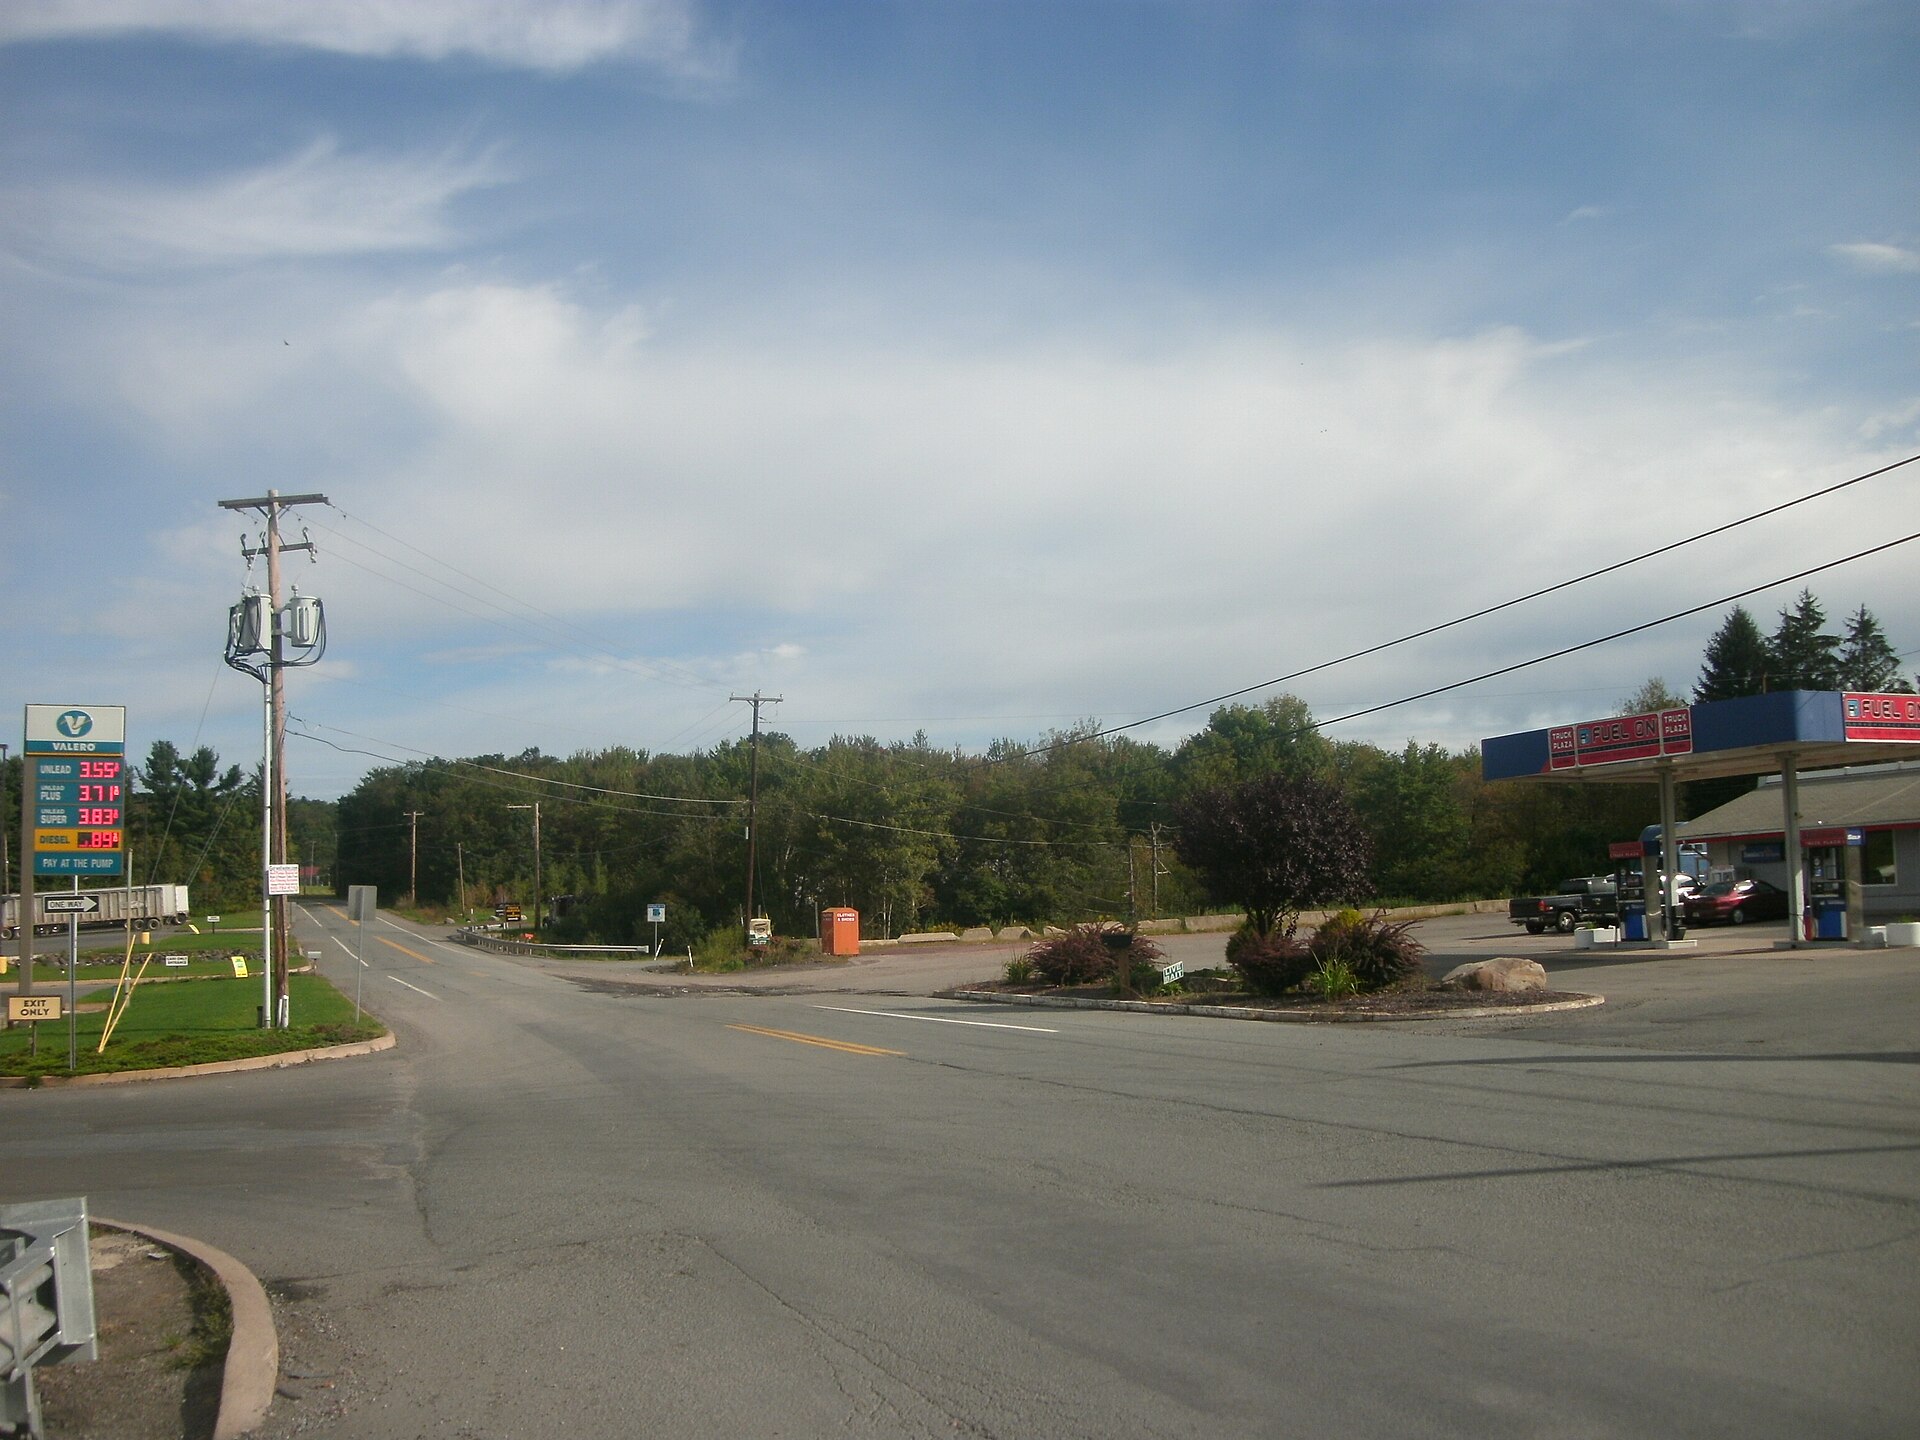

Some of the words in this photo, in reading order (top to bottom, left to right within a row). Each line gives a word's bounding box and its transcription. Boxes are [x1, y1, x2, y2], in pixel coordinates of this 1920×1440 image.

[1861, 699, 1901, 719] FUEL
[1664, 713, 1687, 723] TRUCK
[1592, 722, 1630, 743] FUEL
[1634, 718, 1658, 739] ON
[1665, 724, 1688, 734] PLAZA
[1552, 730, 1572, 740] TRUCK
[52, 742, 96, 752] VALERO
[1553, 740, 1573, 750] PLAZA
[40, 765, 71, 774] UNLEAD
[40, 791, 61, 801] PLUS
[41, 815, 67, 824] SUPER
[40, 835, 70, 844] DIESEL
[43, 858, 58, 868] PAY
[61, 858, 71, 868] AT
[74, 858, 88, 868] THE
[91, 859, 114, 869] PUMP
[50, 901, 65, 909] ONE
[67, 900, 83, 908] WAY
[23, 999, 46, 1007] EXIT
[20, 1008, 50, 1016] ONLY
